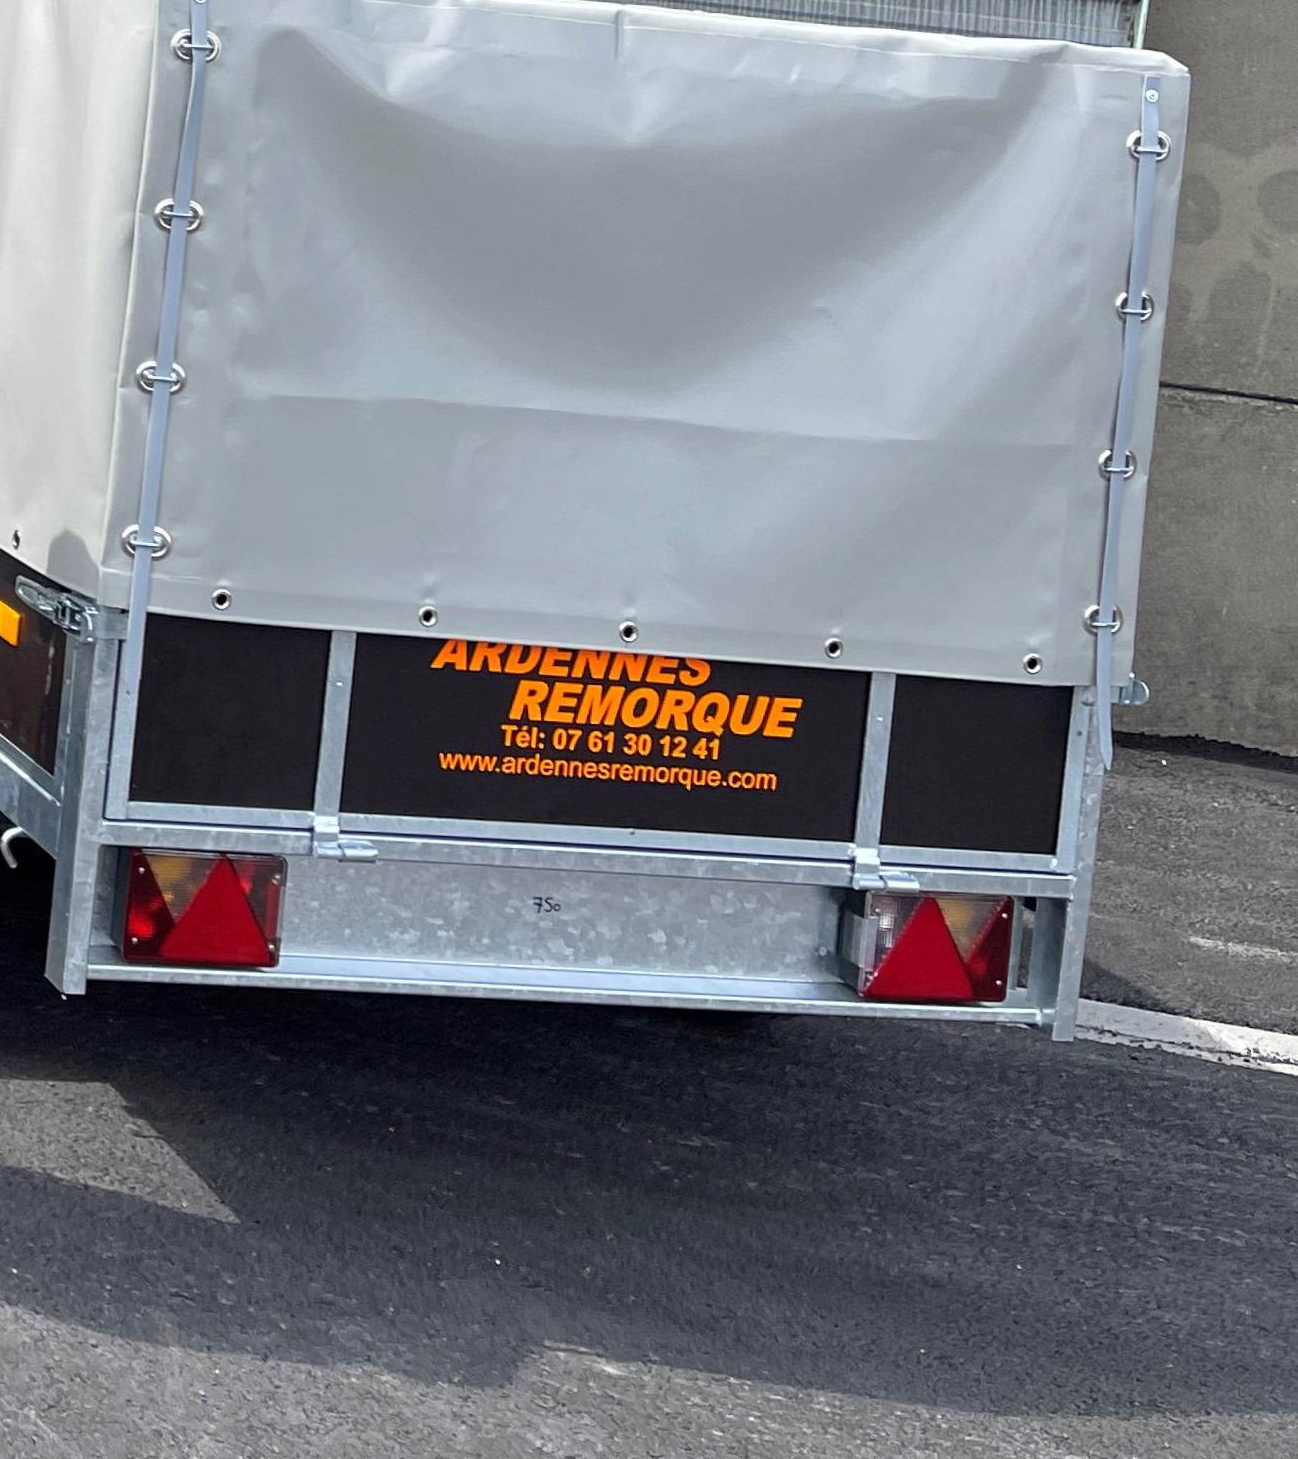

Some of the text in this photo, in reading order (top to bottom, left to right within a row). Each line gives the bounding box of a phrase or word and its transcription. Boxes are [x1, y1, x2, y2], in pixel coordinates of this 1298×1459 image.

[430, 638, 712, 687] ARDENNES
[508, 679, 804, 739] REMORQUE
[501, 724, 721, 761] Tél: 07 61 30 12 41
[438, 751, 778, 791] www.ardennesremorque.com
[533, 896, 561, 914] 750
